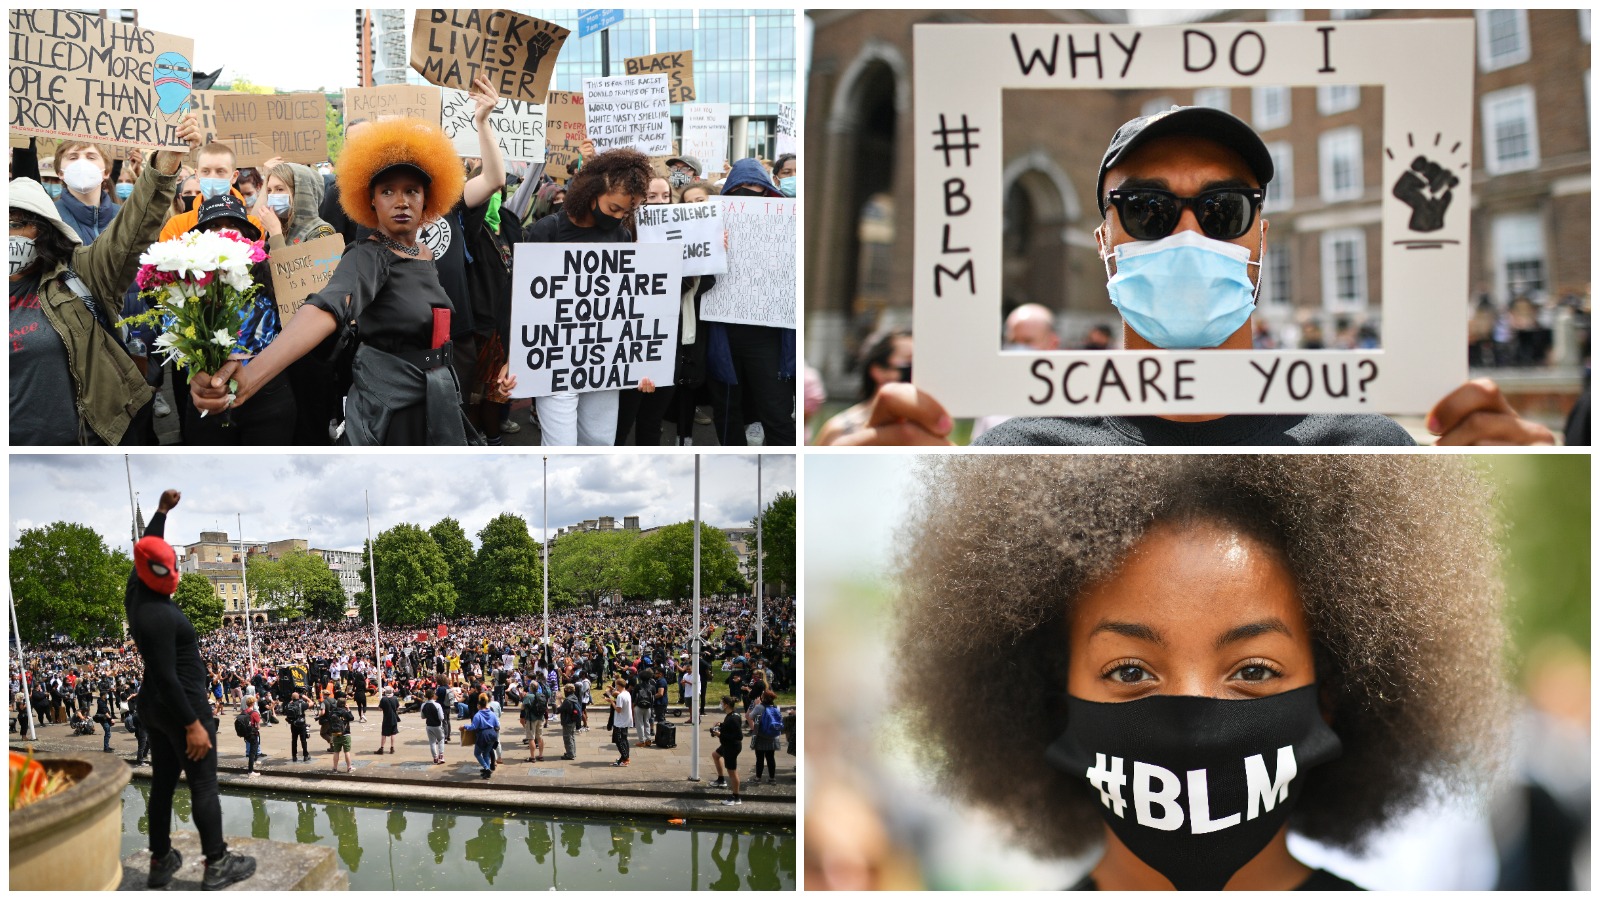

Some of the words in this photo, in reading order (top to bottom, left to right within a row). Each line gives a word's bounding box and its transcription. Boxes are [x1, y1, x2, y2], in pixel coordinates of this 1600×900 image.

[9, 9, 106, 47] ACISM
[110, 23, 155, 54] HAS
[430, 9, 530, 47] BLACK
[9, 31, 88, 71] ILLED
[88, 45, 153, 85] MORE
[428, 28, 517, 66] LIVES
[1010, 31, 1142, 79] WHY
[1182, 29, 1266, 76] DO
[1316, 26, 1337, 73] I
[421, 56, 536, 99] MATTER
[626, 53, 684, 75] BLACK
[9, 65, 67, 104] OPLE
[76, 77, 153, 118] THAN
[587, 81, 603, 89] THIS
[638, 77, 662, 85] RACIST
[639, 87, 650, 96] OF
[651, 86, 665, 94] THE
[220, 101, 257, 123] WHO
[267, 99, 320, 121] POLICES
[353, 93, 397, 110] RACISM
[416, 93, 428, 106] IS
[442, 91, 471, 118] ONL
[548, 92, 568, 105] IT'S
[615, 102, 632, 111] YOU
[634, 100, 649, 110] BIG
[652, 99, 667, 108] FAT
[9, 95, 92, 134] ORONA
[95, 111, 152, 143] EVER
[444, 110, 472, 139] CAN
[470, 114, 544, 137] CNQUER
[588, 114, 611, 123] WHITE
[612, 113, 637, 122] NASTY
[588, 125, 603, 135] FAT
[605, 124, 627, 134] BITCH
[229, 132, 260, 156] THE
[271, 129, 322, 153] POLICE?
[499, 137, 535, 158] ATE
[638, 207, 669, 227] WHITE
[672, 205, 717, 223] SILENCE
[722, 200, 746, 213] SAY
[932, 113, 980, 298] #BLM
[432, 217, 450, 258] OICES
[682, 242, 711, 260] ENCE
[275, 254, 313, 279] INJUSTICE
[564, 249, 636, 275] NONE
[289, 280, 298, 289] IS
[301, 279, 306, 287] A
[530, 275, 568, 299] OF
[574, 274, 611, 298] US
[617, 273, 668, 296] ARE
[279, 304, 289, 314] TO
[555, 296, 644, 323] EQUAL
[521, 321, 613, 347] UNTIL
[619, 318, 668, 342] ALL
[526, 346, 564, 370] OF
[570, 344, 606, 367] US
[611, 340, 663, 364] ARE
[551, 363, 639, 392] EQUAL
[1028, 357, 1196, 404] SCARE
[1249, 356, 1379, 404] YOU?
[1085, 744, 1298, 835] #BLM
